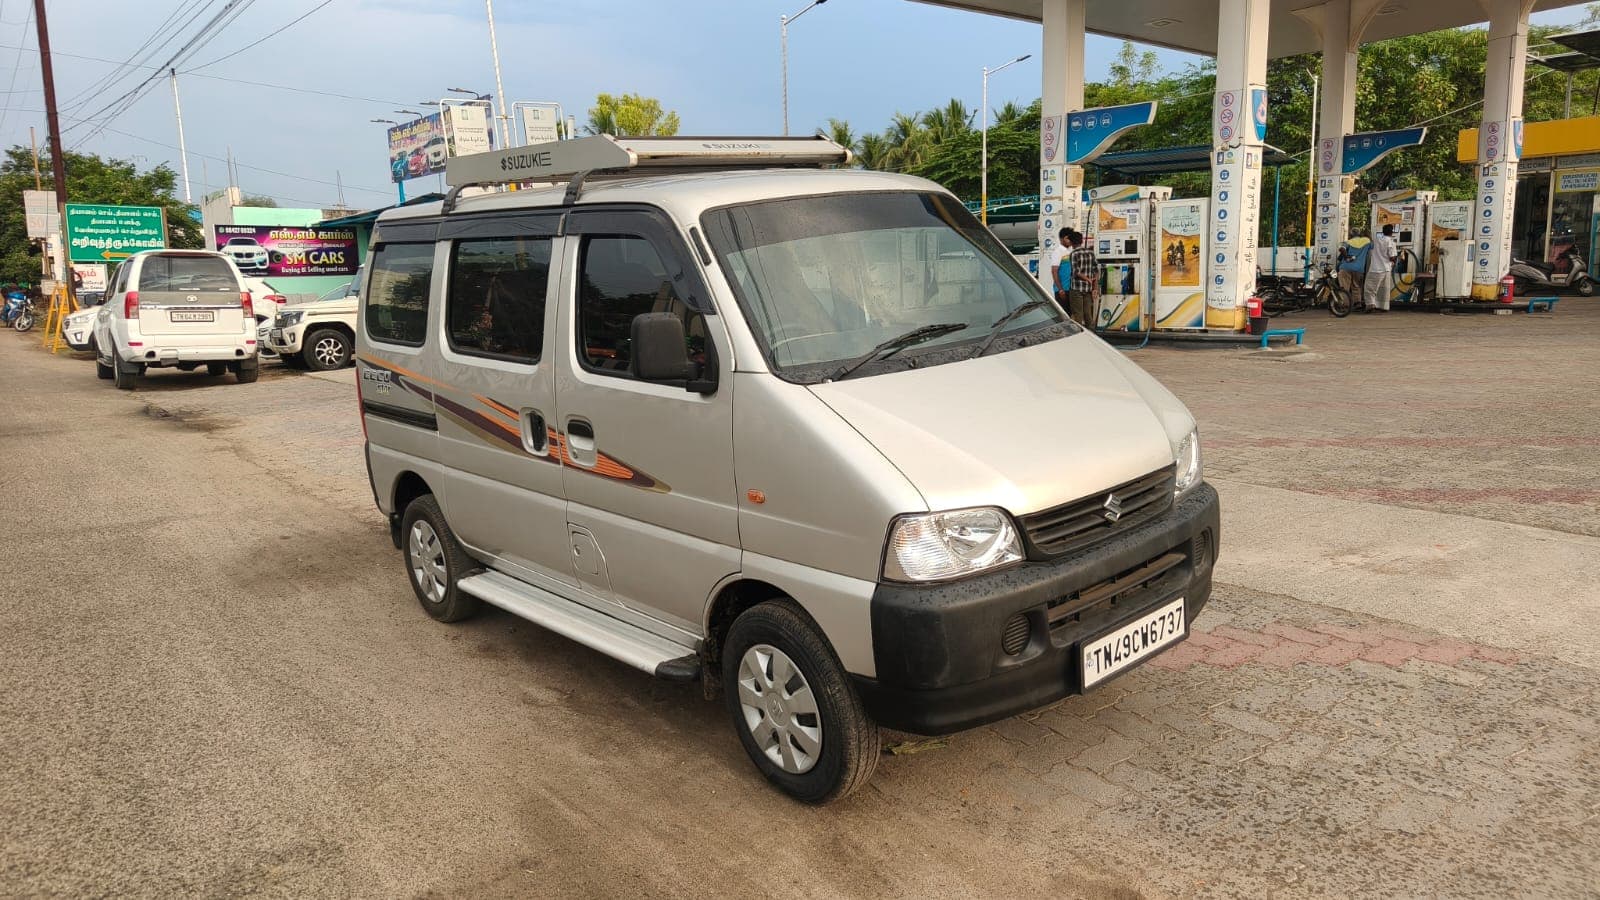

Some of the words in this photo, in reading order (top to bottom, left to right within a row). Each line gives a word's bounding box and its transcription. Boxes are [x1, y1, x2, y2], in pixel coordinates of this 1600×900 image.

[1074, 140, 1078, 152] 1
[507, 153, 542, 170] SUZUKI
[71, 236, 165, 250] அறிவுத்திருக்கோயில்
[286, 252, 306, 265] SM
[309, 251, 345, 264] CARS
[281, 266, 301, 274] Buying
[307, 266, 325, 274] Selling
[1093, 606, 1183, 674] TN49CW6737
